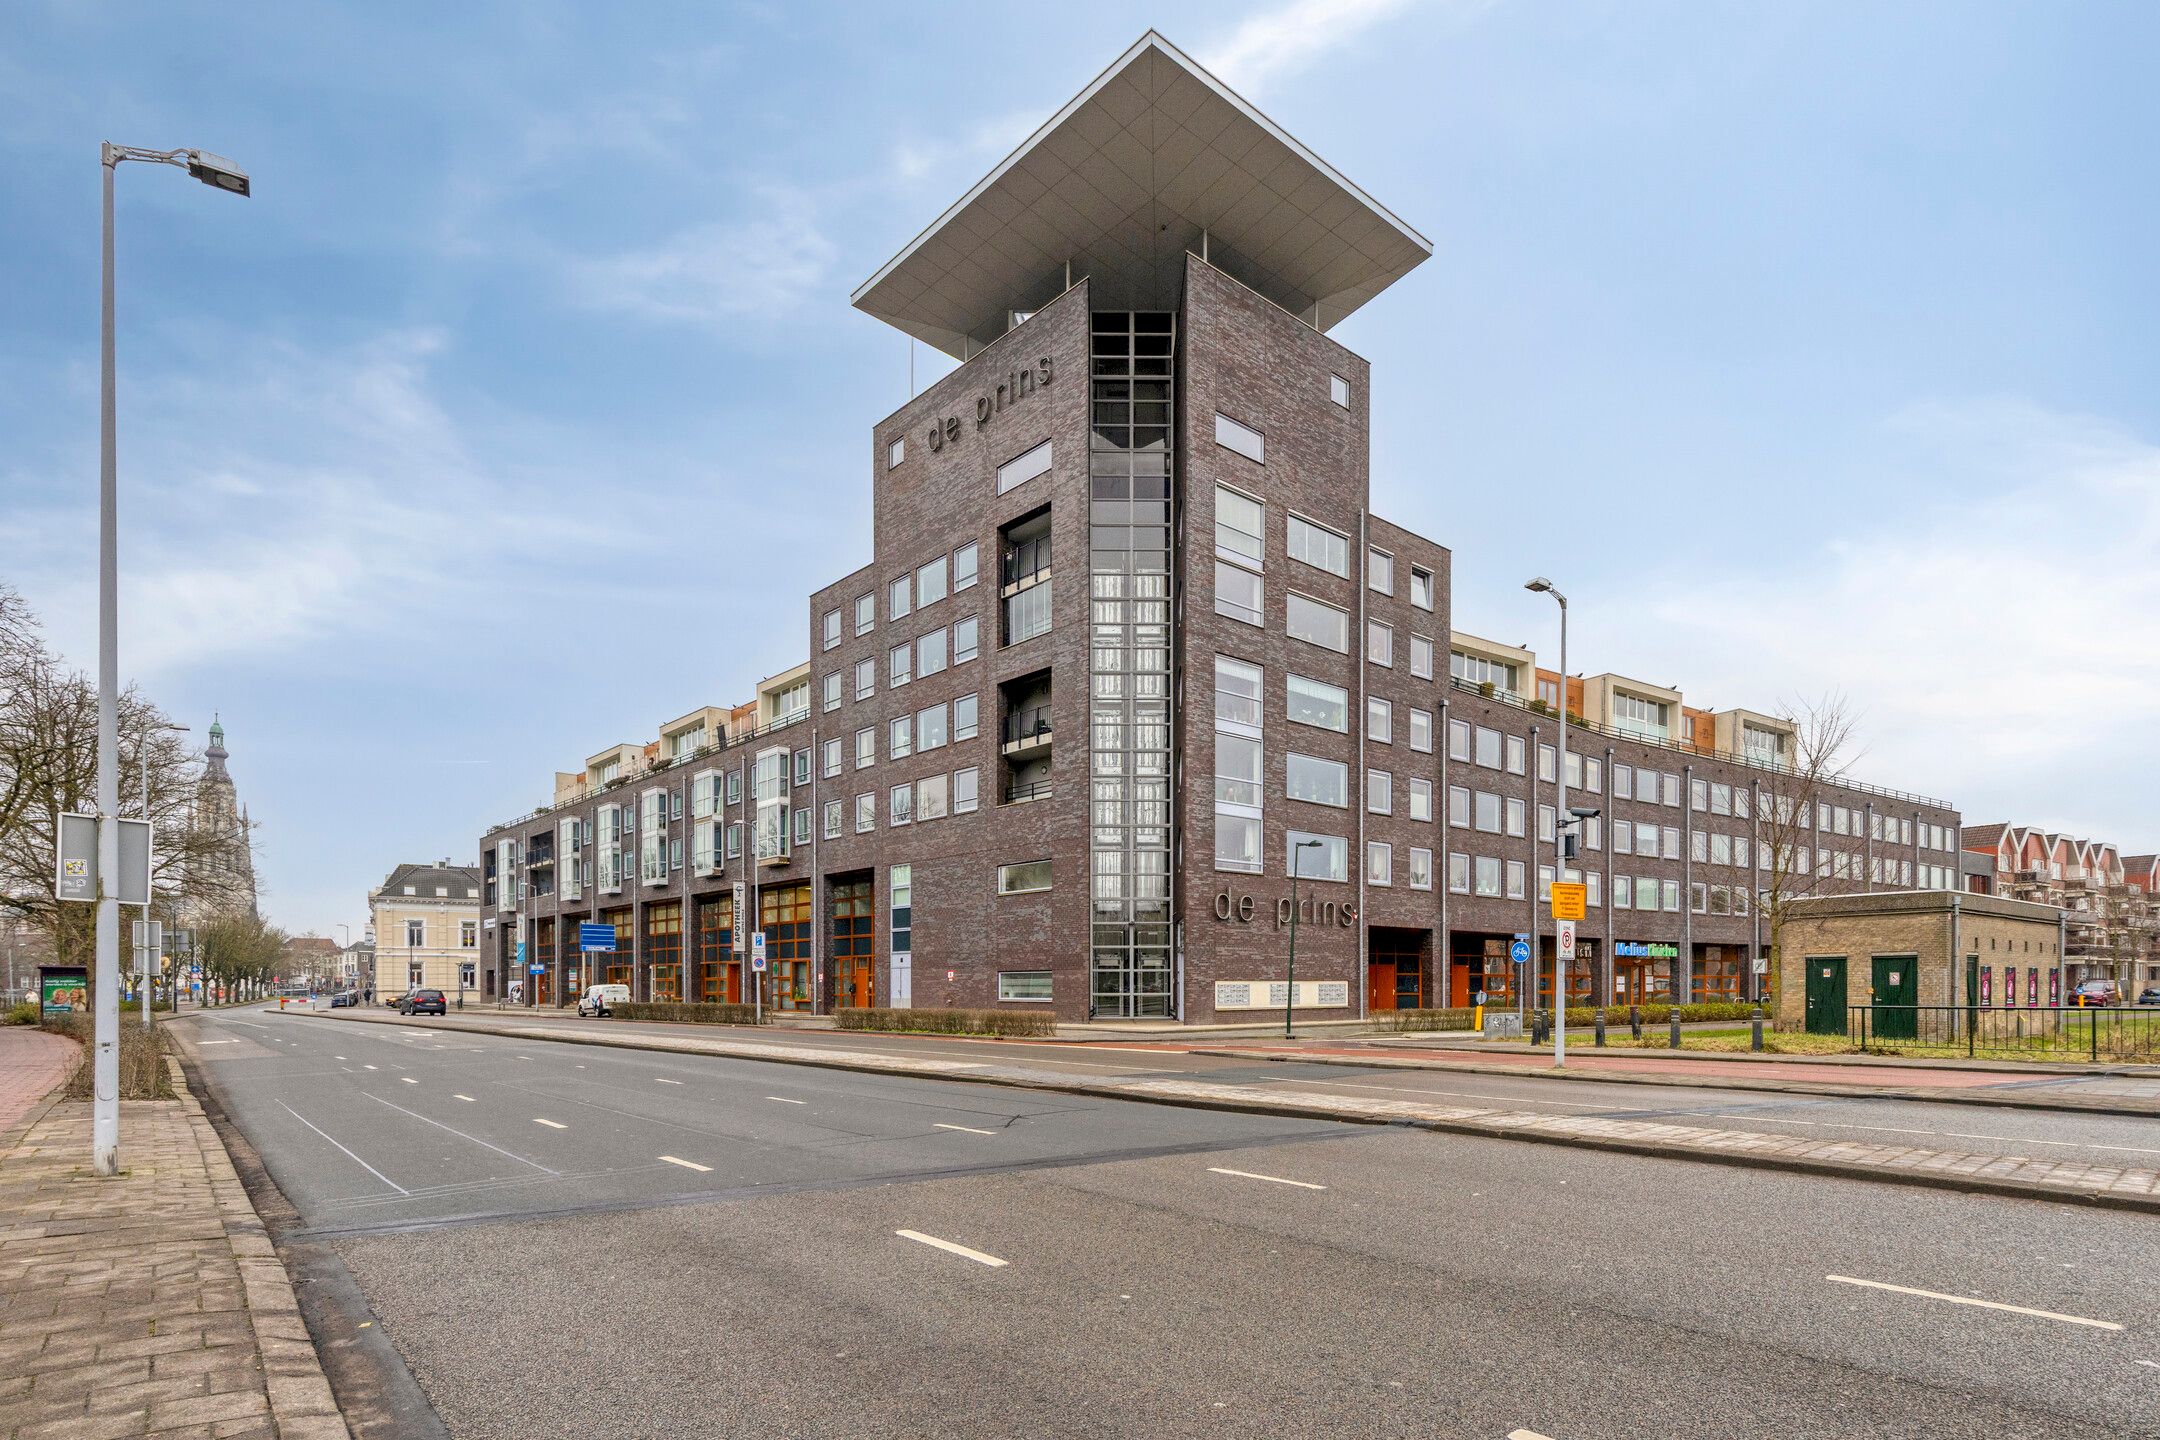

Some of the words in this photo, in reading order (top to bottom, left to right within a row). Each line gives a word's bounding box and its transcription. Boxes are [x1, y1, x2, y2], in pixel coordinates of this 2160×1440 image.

[928, 417, 959, 453] de
[976, 356, 1051, 431] prins
[1215, 886, 1255, 921] de
[1277, 892, 1354, 930] prins
